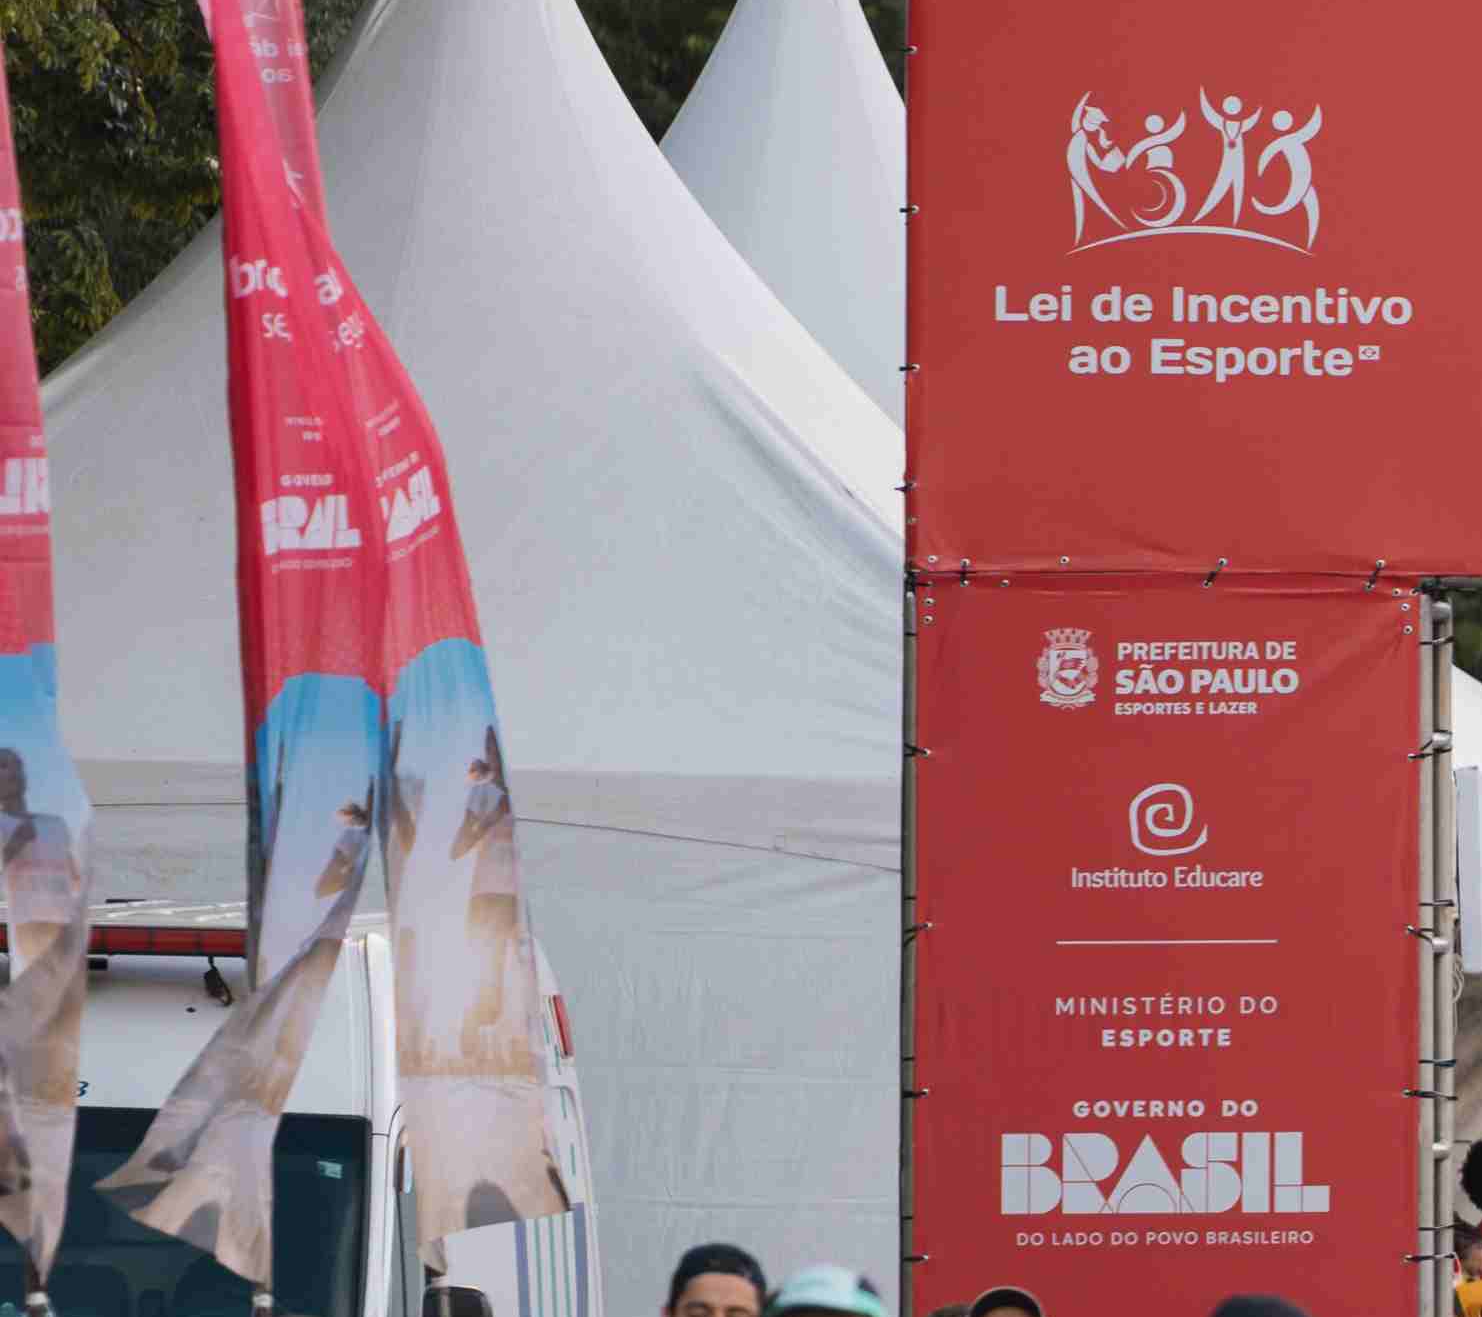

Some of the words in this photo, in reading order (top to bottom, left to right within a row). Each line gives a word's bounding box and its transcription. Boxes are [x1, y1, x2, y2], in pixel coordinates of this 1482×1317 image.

[995, 285, 1072, 322] Lei
[1091, 285, 1153, 323] de
[1172, 286, 1413, 325] Incentivo
[1068, 345, 1131, 375] ao
[1150, 338, 1354, 383] Esporte
[1117, 641, 1260, 661] PREFEITURA
[1265, 641, 1297, 660] DE
[1115, 663, 1185, 695] SÃO
[1190, 668, 1299, 694] PAULO
[1114, 702, 1192, 716] ESPORTES
[1195, 701, 1205, 715] E
[1208, 701, 1258, 715] LAZER
[1071, 866, 1168, 888] Instituto
[1174, 864, 1264, 888] Educare
[1055, 992, 1226, 1015] MINISTÉRIO
[1239, 995, 1278, 1015] DO
[1101, 1028, 1231, 1048] ESPORTE
[1072, 1099, 1205, 1118] GOVERNO
[1221, 1099, 1259, 1117] DO
[1001, 1131, 1330, 1215] BRASIL
[1016, 1232, 1045, 1246] DO
[1051, 1231, 1104, 1246] LADO
[1110, 1231, 1139, 1246] DO
[1145, 1231, 1199, 1245] POVO
[1205, 1230, 1314, 1245] BRASILEIRO
